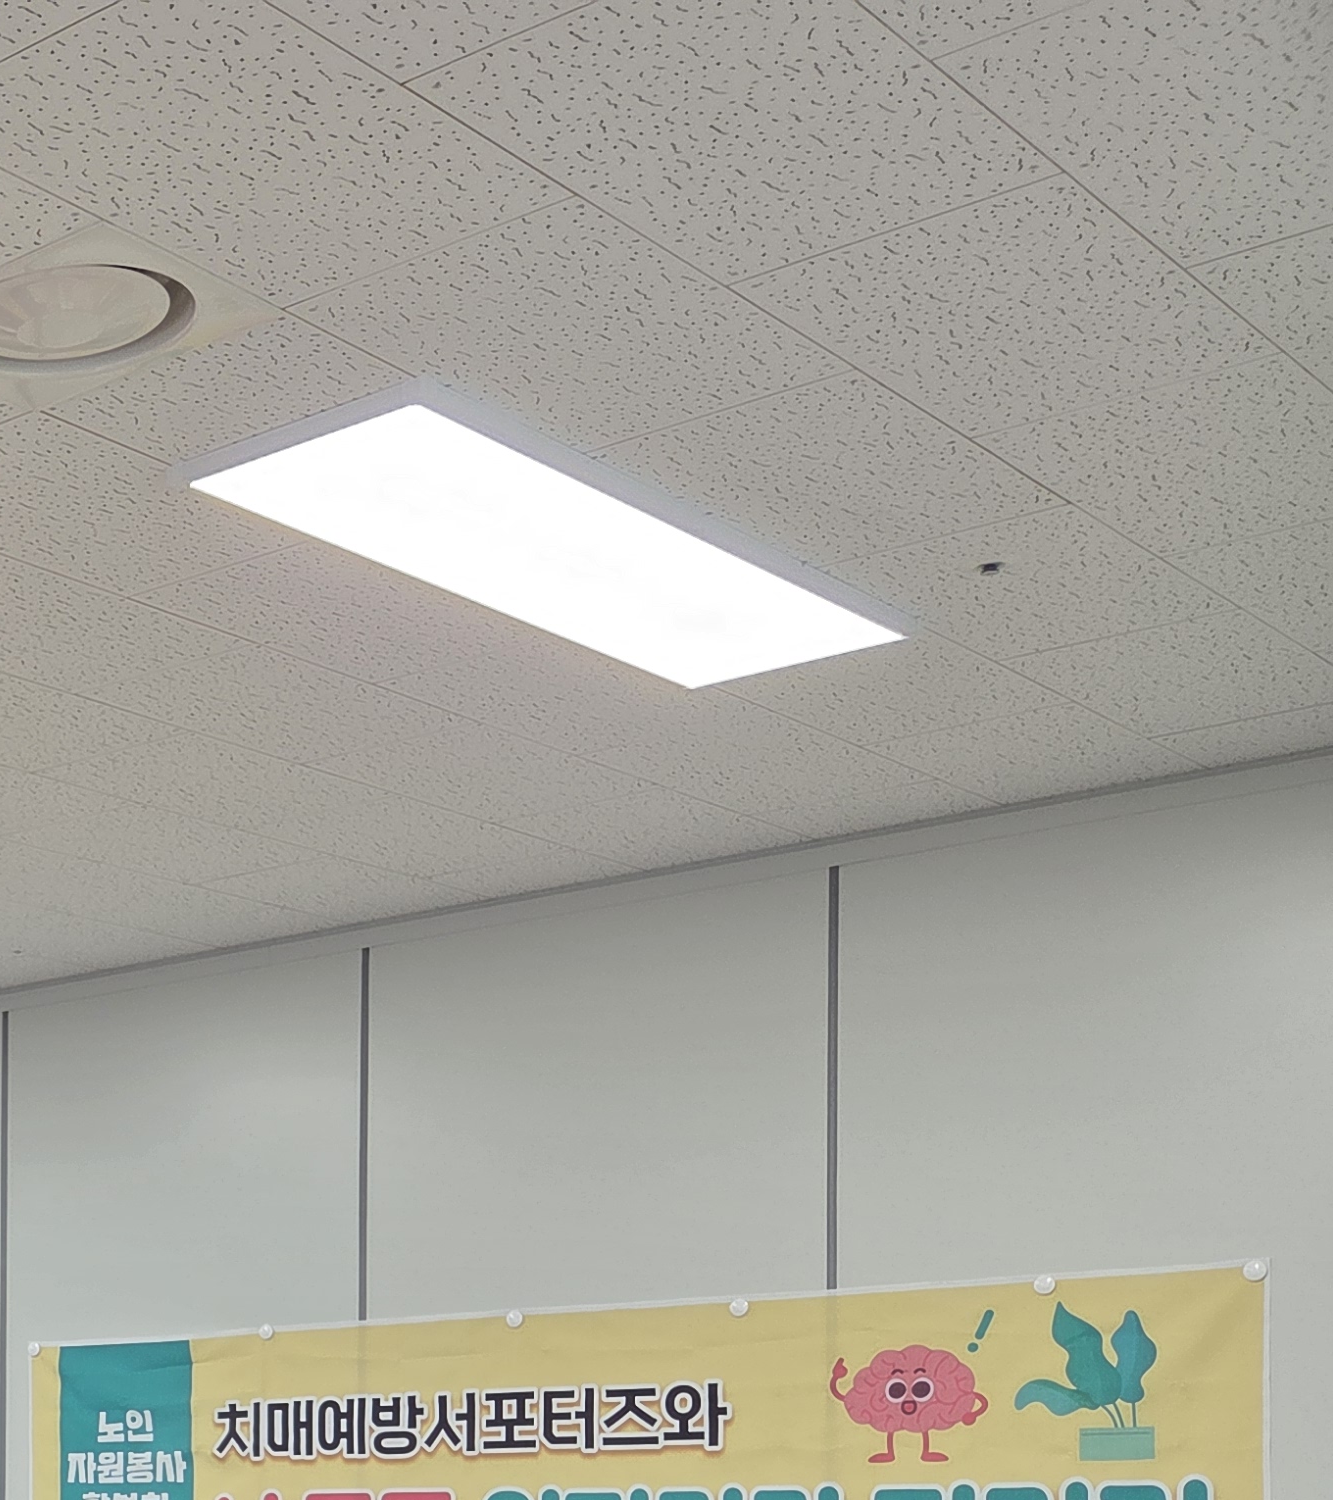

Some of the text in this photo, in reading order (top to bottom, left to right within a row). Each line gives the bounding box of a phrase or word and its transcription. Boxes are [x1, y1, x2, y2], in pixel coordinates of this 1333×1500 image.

[97, 1409, 154, 1442] 노인
[213, 1382, 728, 1458] 치매예방서포터즈와
[67, 1450, 187, 1484] 자원봉사
